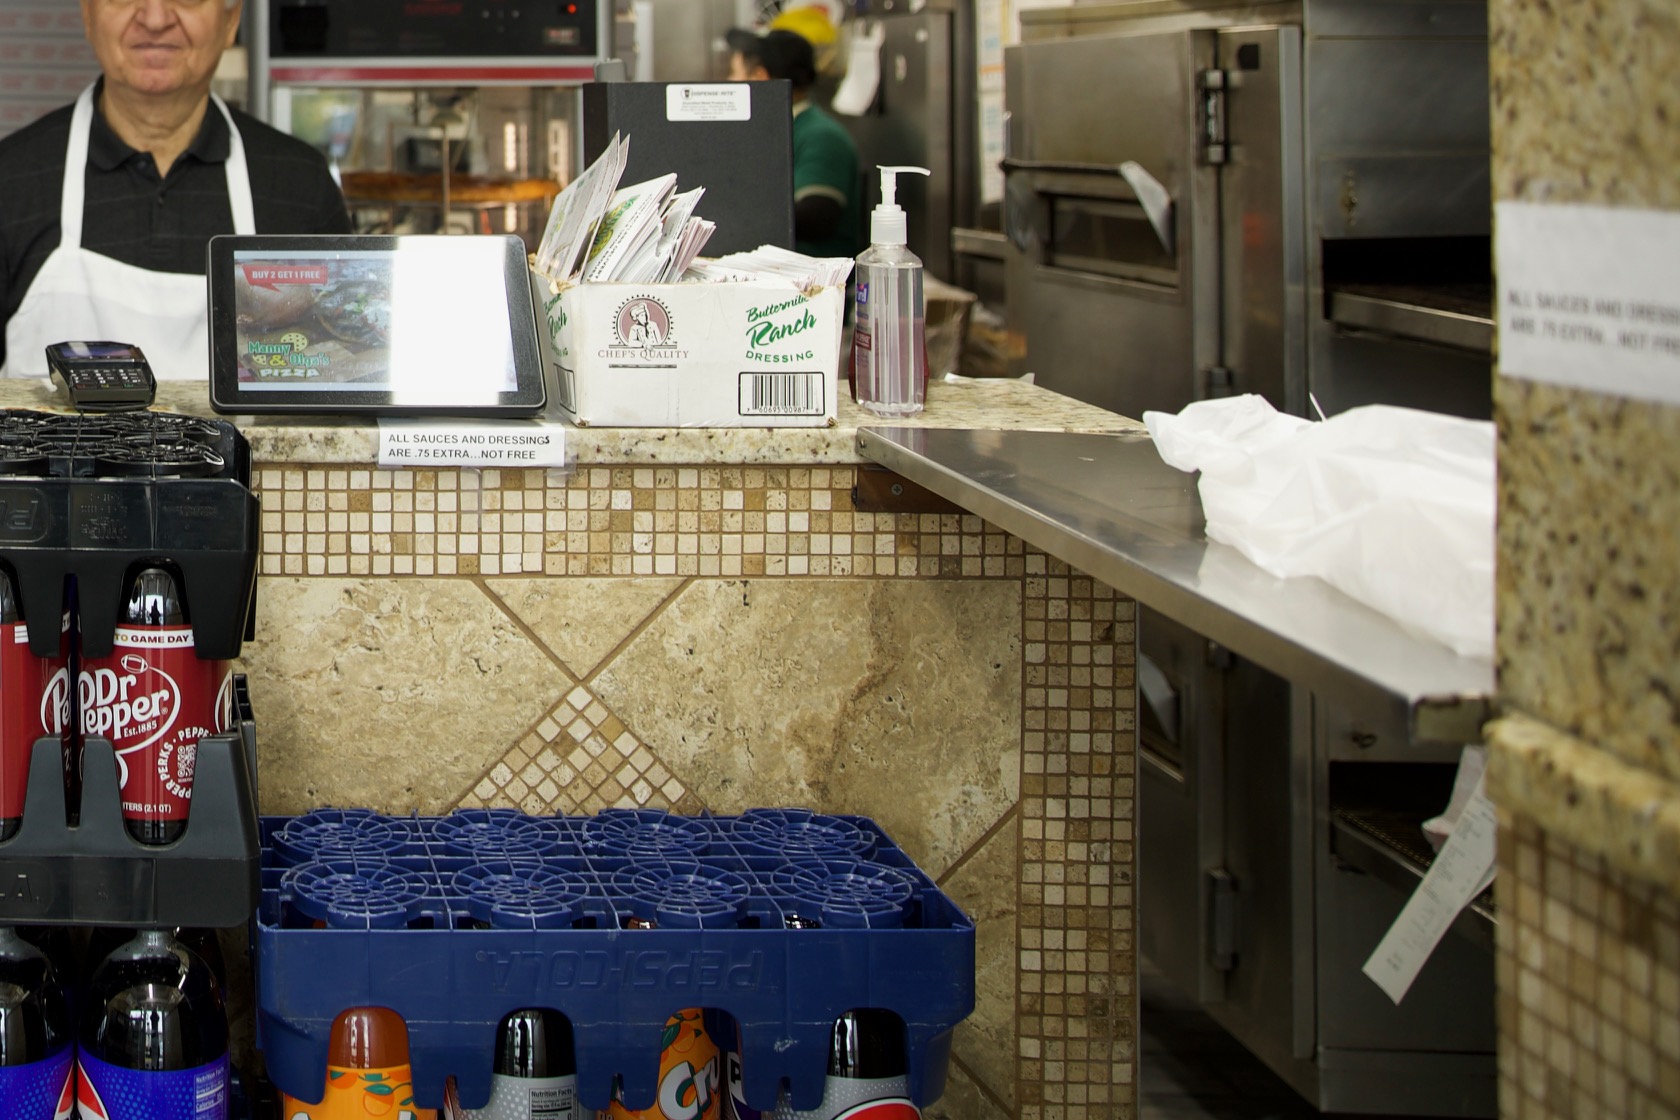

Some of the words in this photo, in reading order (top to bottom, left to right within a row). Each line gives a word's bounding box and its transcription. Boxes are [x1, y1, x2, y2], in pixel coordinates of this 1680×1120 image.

[252, 270, 269, 279] BUY
[270, 270, 276, 279] 2
[277, 270, 293, 279] GET
[299, 270, 321, 280] FREE
[746, 308, 817, 350] Ranch
[597, 349, 637, 359] CHEF'S
[640, 349, 689, 360] QUALITY
[746, 350, 814, 363] DRESSING
[388, 434, 410, 445] ALL
[412, 434, 459, 445] SAUCES
[461, 434, 486, 445] AND
[488, 434, 551, 446] DRESSINGS
[388, 448, 412, 458] ARE
[414, 448, 430, 459] .75
[507, 450, 536, 460] FREE
[131, 635, 165, 644] GAME
[167, 635, 190, 643] DAY
[95, 668, 137, 701] Dr
[77, 669, 170, 741] Pepper
